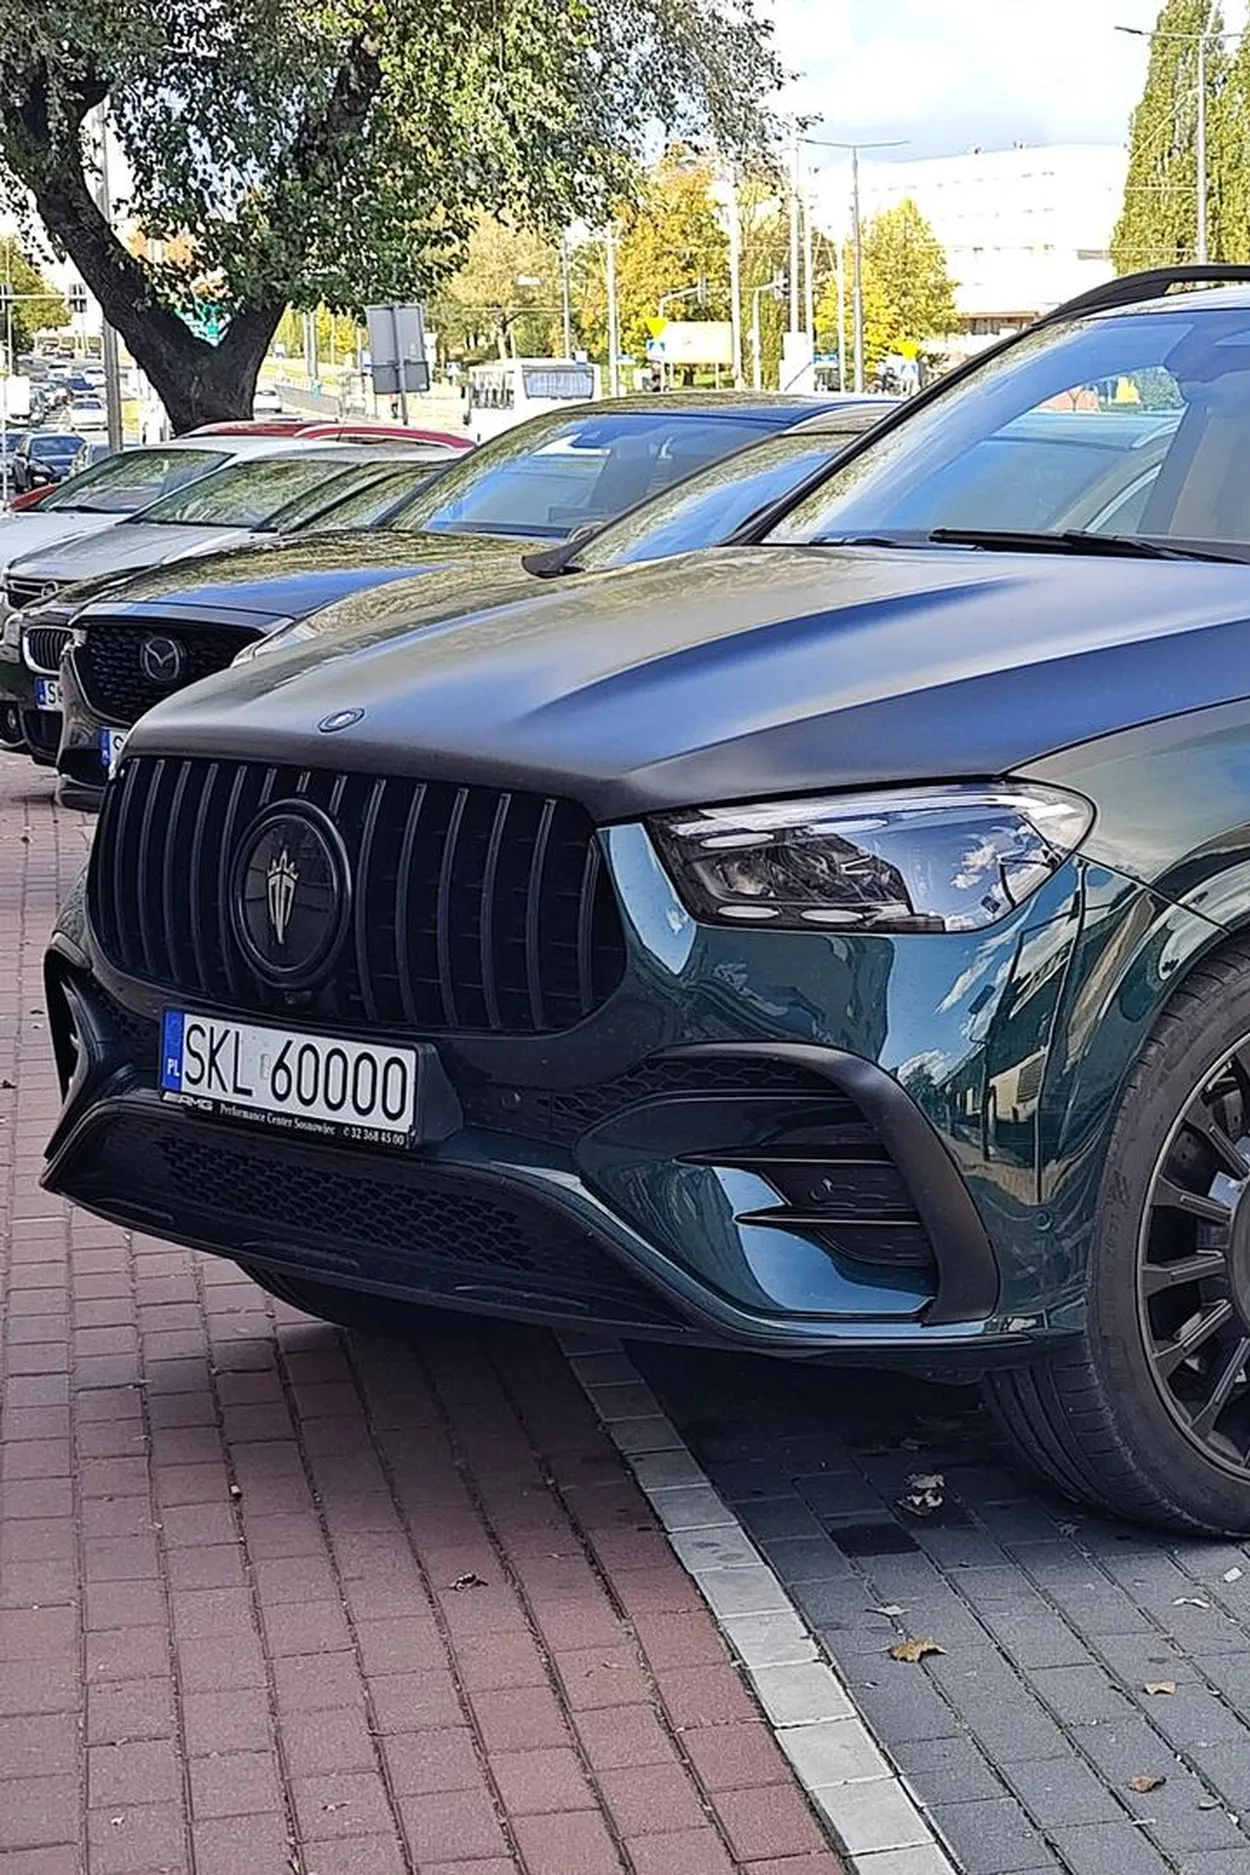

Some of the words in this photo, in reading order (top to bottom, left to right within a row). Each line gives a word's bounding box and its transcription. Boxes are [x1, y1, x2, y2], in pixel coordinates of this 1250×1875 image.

[167, 1058, 181, 1077] PL
[184, 1023, 253, 1097] SKL
[270, 1040, 407, 1121] 60000
[219, 1104, 266, 1122] Performance
[267, 1112, 292, 1127] Center
